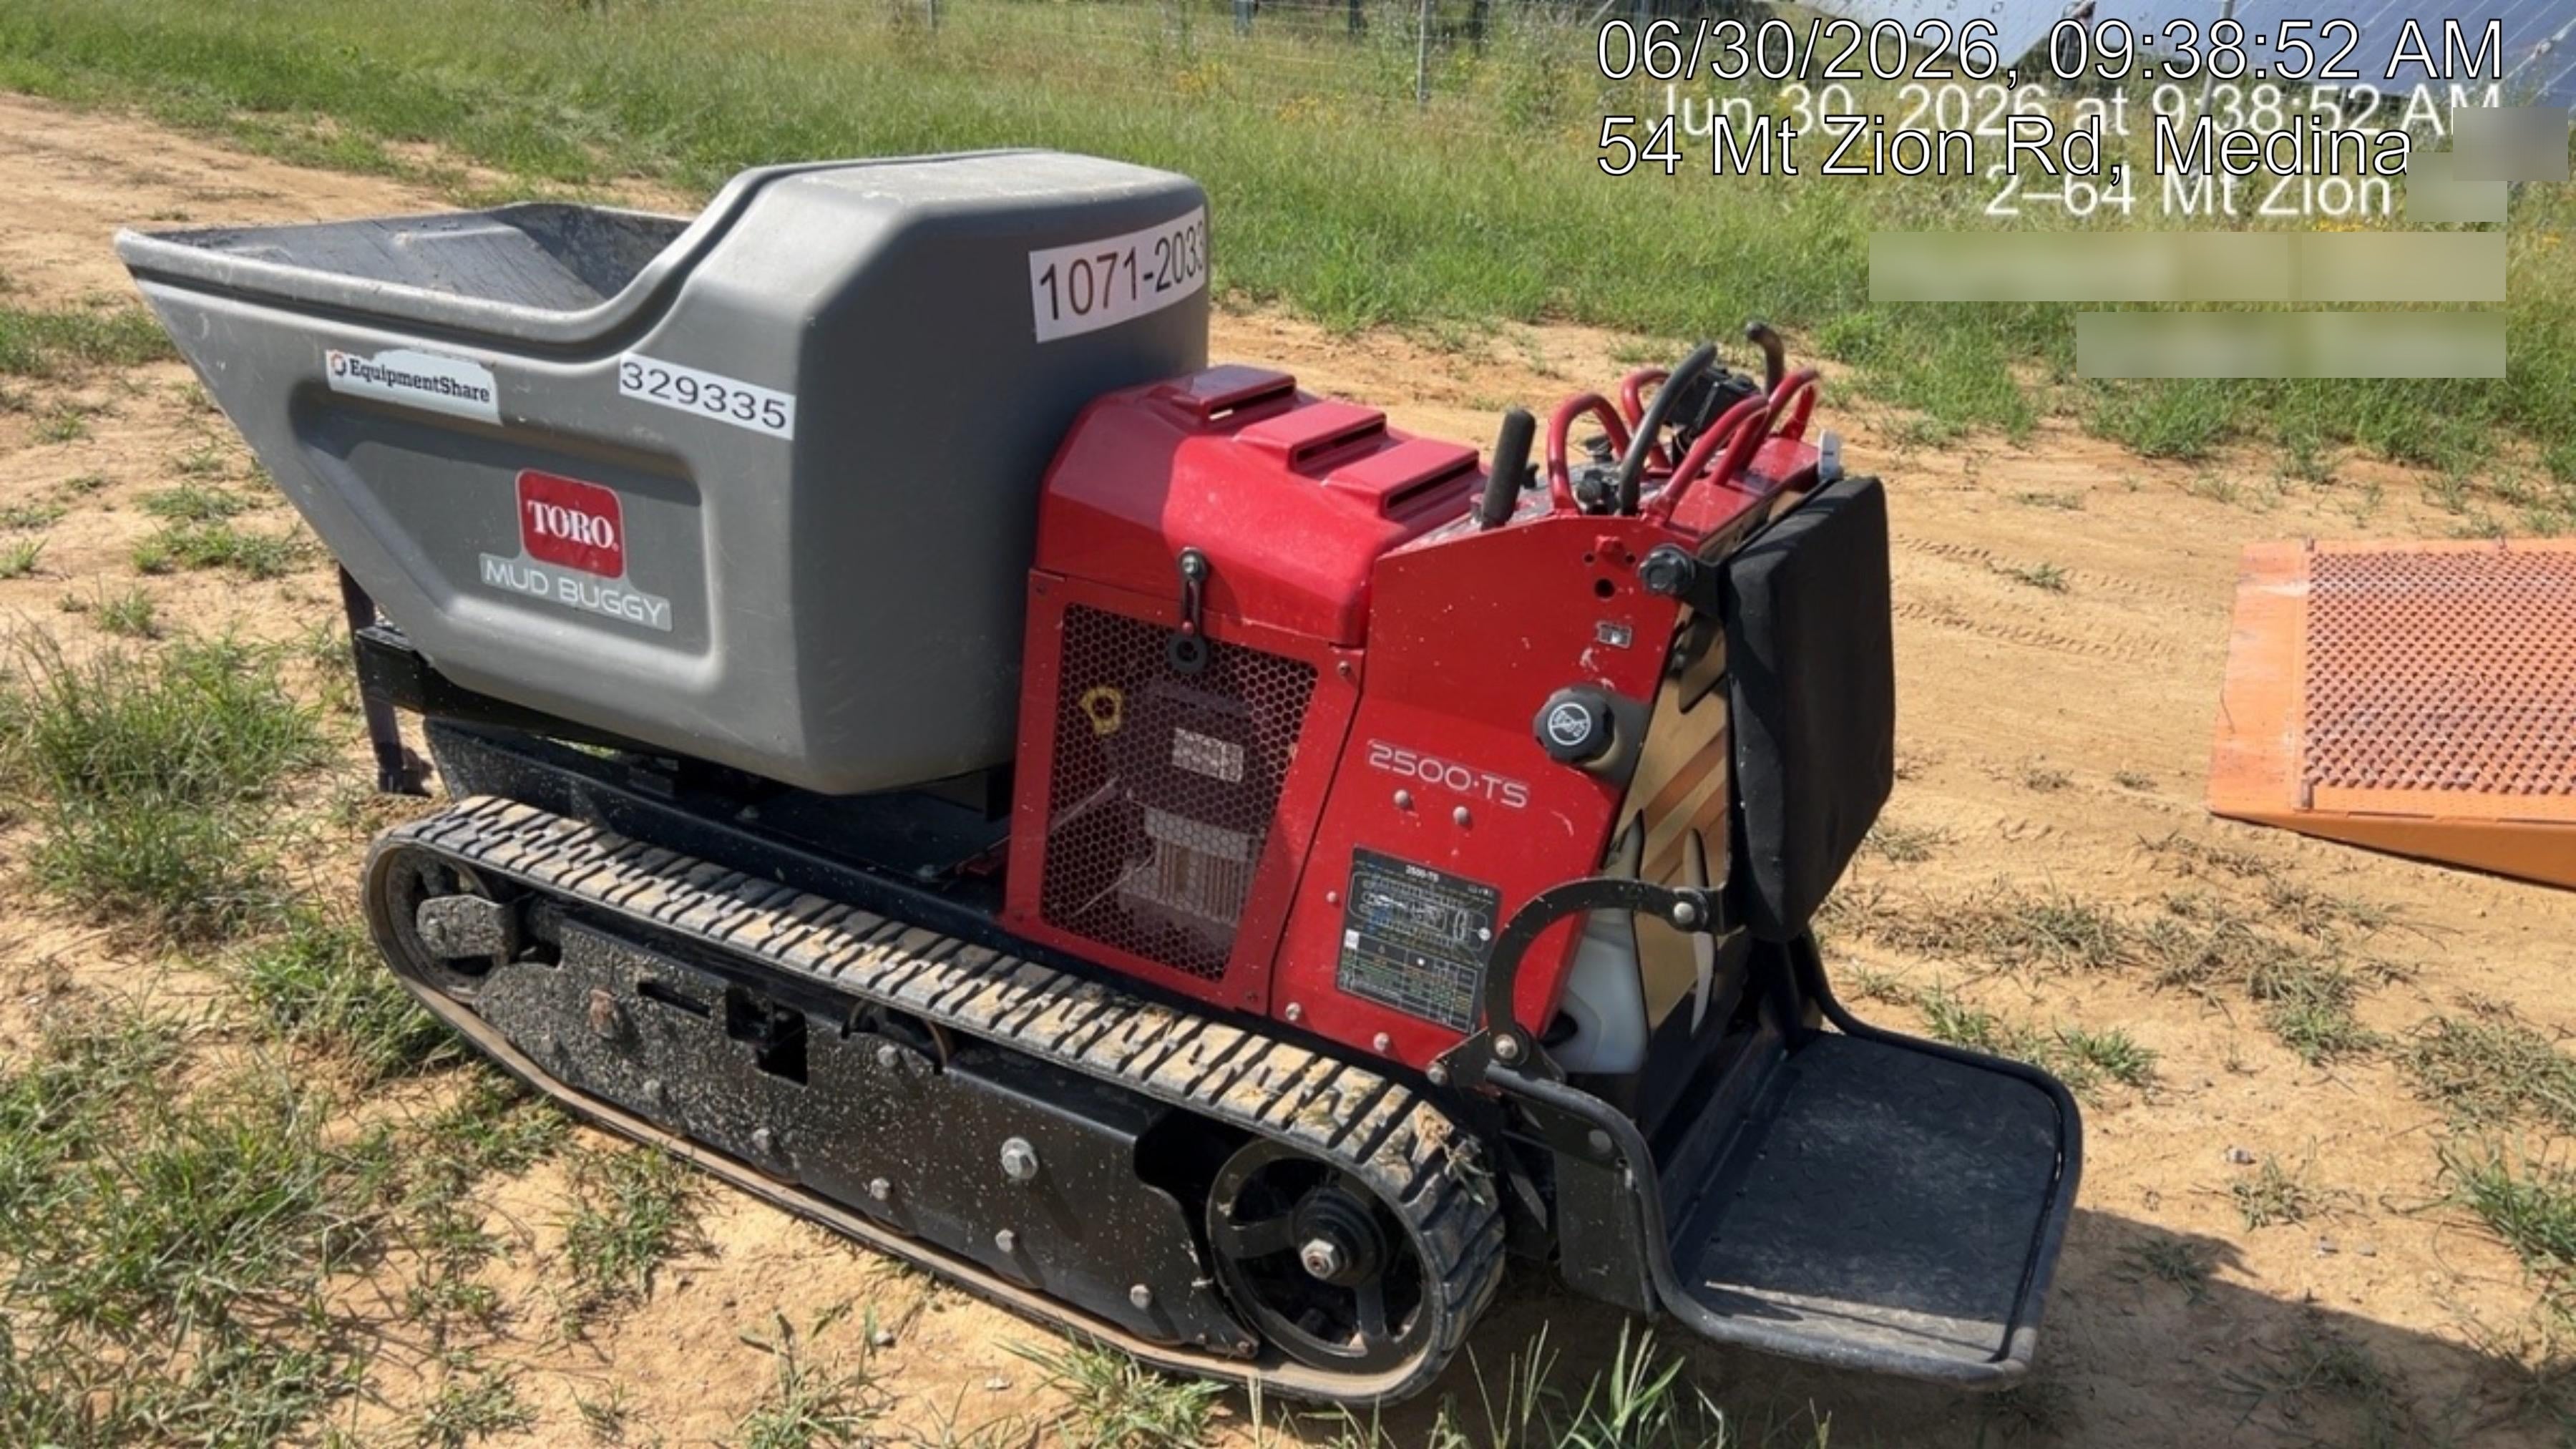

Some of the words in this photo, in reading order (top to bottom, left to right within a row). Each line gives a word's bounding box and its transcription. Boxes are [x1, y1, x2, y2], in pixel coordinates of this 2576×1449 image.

[350, 358, 490, 402] EquipmentShare
[622, 361, 786, 429] 329335
[527, 499, 615, 549] TORO
[486, 559, 550, 595] MUD
[558, 576, 663, 625] BUGGY
